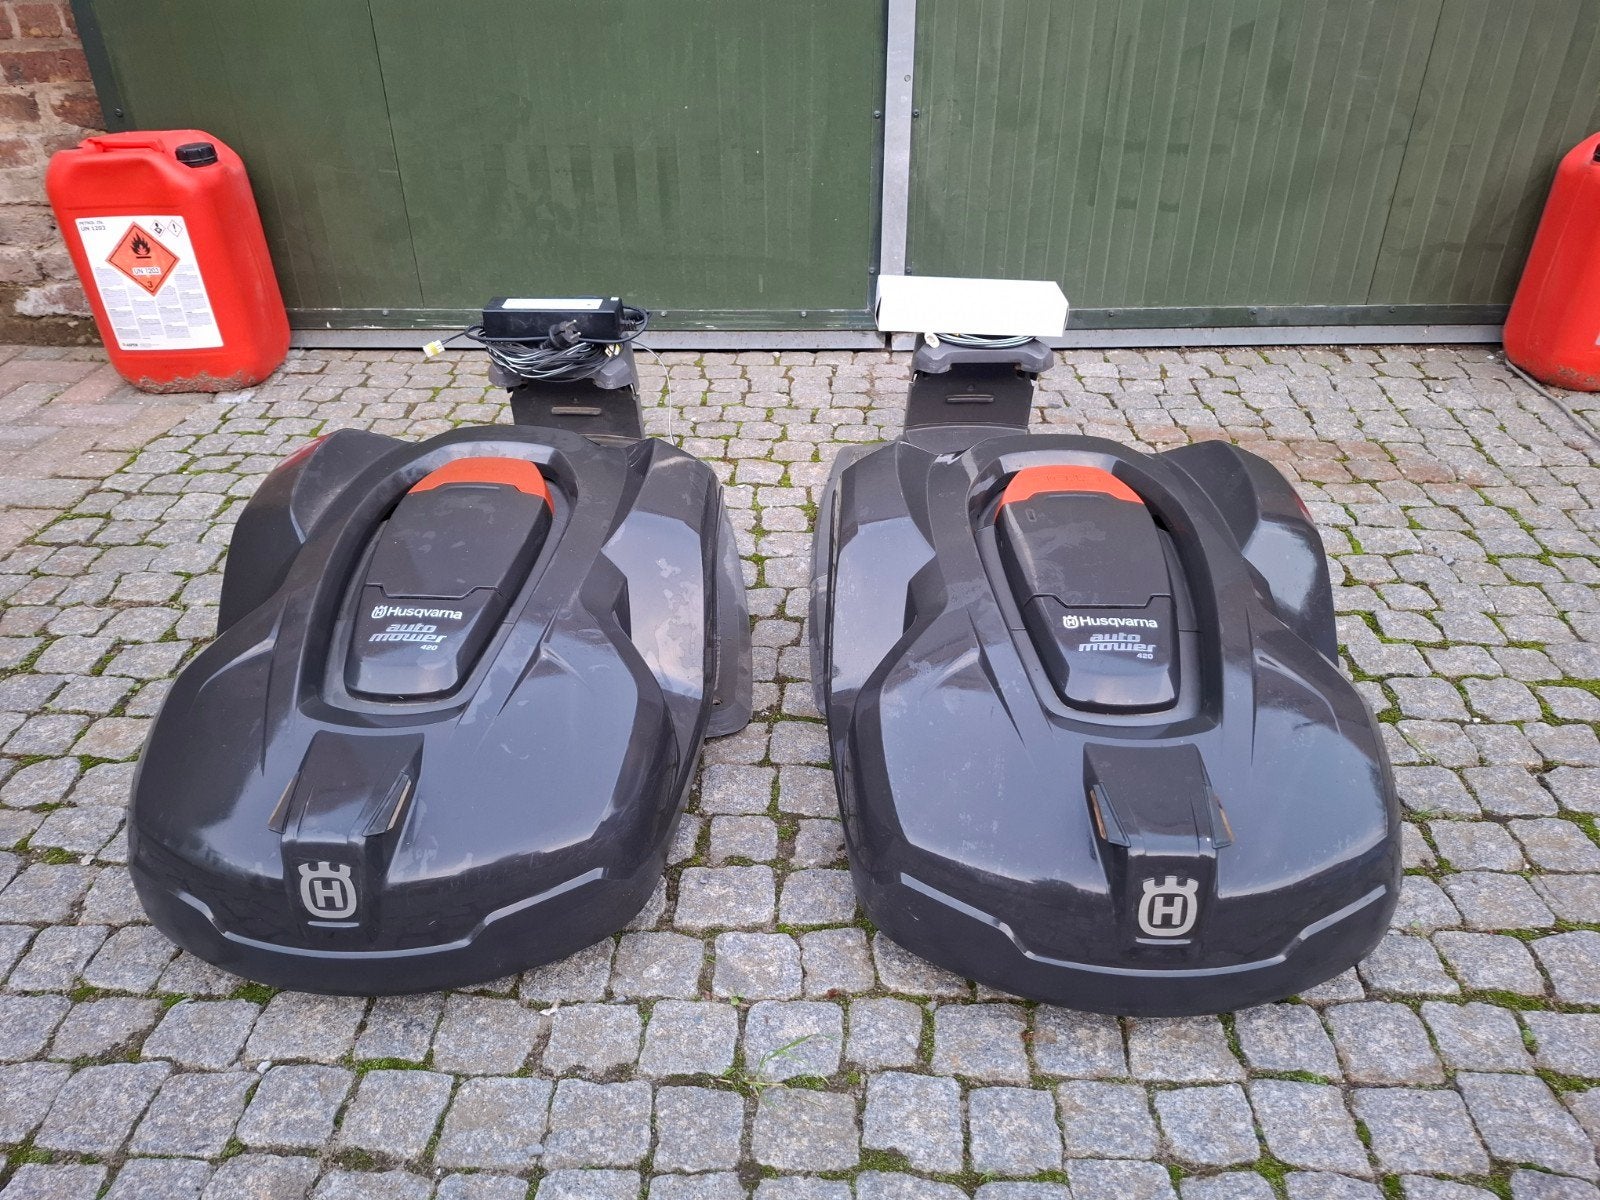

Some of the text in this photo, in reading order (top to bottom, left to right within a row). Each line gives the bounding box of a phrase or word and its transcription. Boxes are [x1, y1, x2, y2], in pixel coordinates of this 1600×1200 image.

[147, 280, 153, 288] 3
[386, 606, 463, 620] Husqvarna
[385, 622, 438, 633] auto
[1079, 615, 1159, 629] Husqvarna
[368, 632, 448, 643] mower
[1089, 632, 1141, 642] auto
[1078, 642, 1157, 653] mower
[1136, 652, 1154, 660] 420
